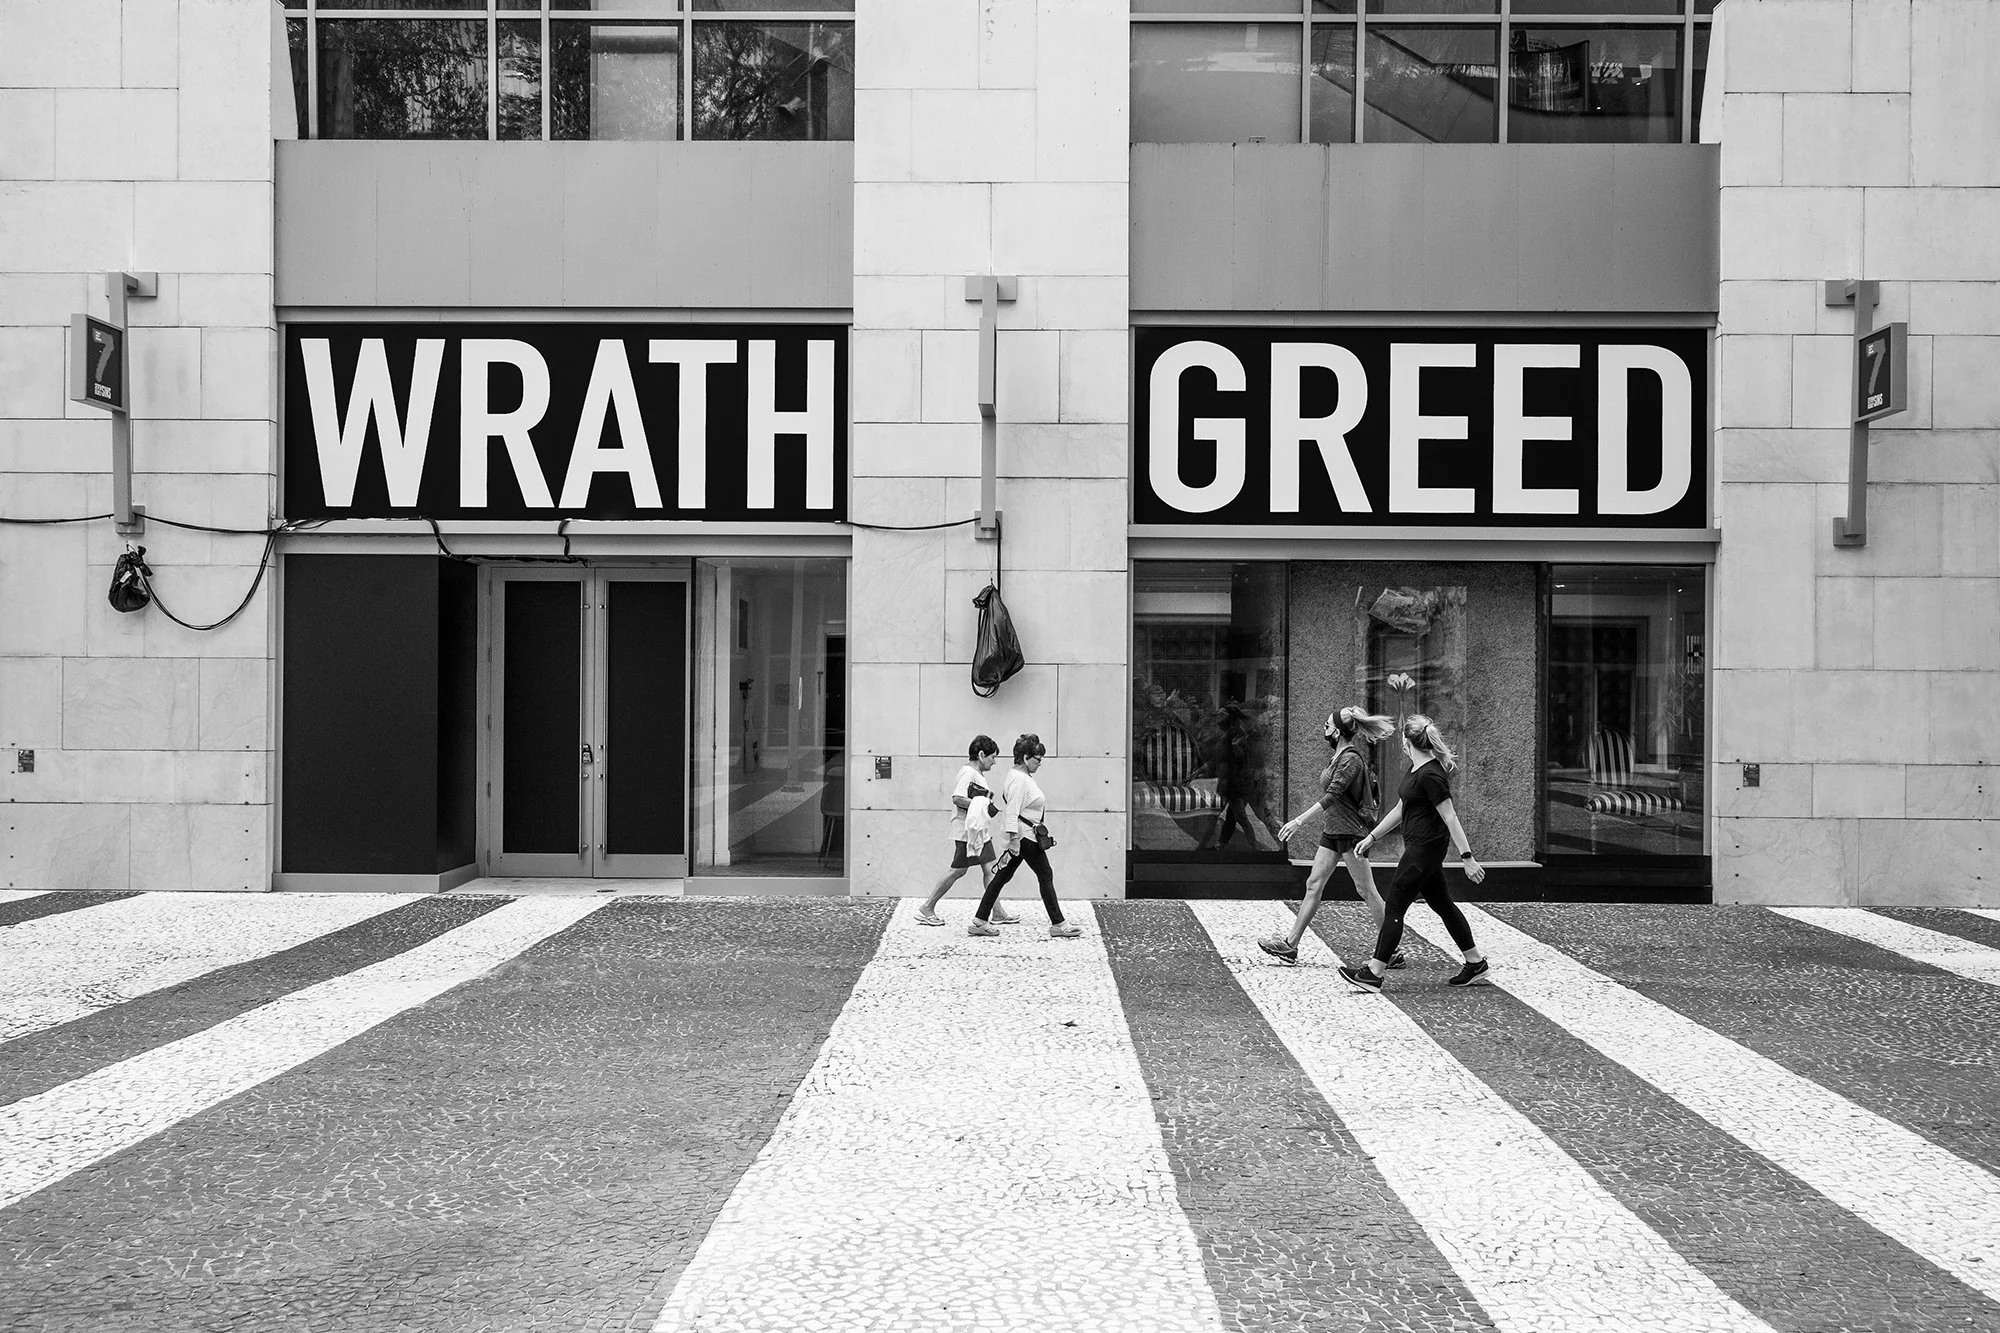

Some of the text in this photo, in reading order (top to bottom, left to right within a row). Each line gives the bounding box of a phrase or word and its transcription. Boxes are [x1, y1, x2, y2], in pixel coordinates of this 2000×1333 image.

[92, 327, 115, 383] 7
[1866, 338, 1886, 396] 7
[299, 337, 836, 510] WRATH
[1148, 340, 1693, 515] GREED
